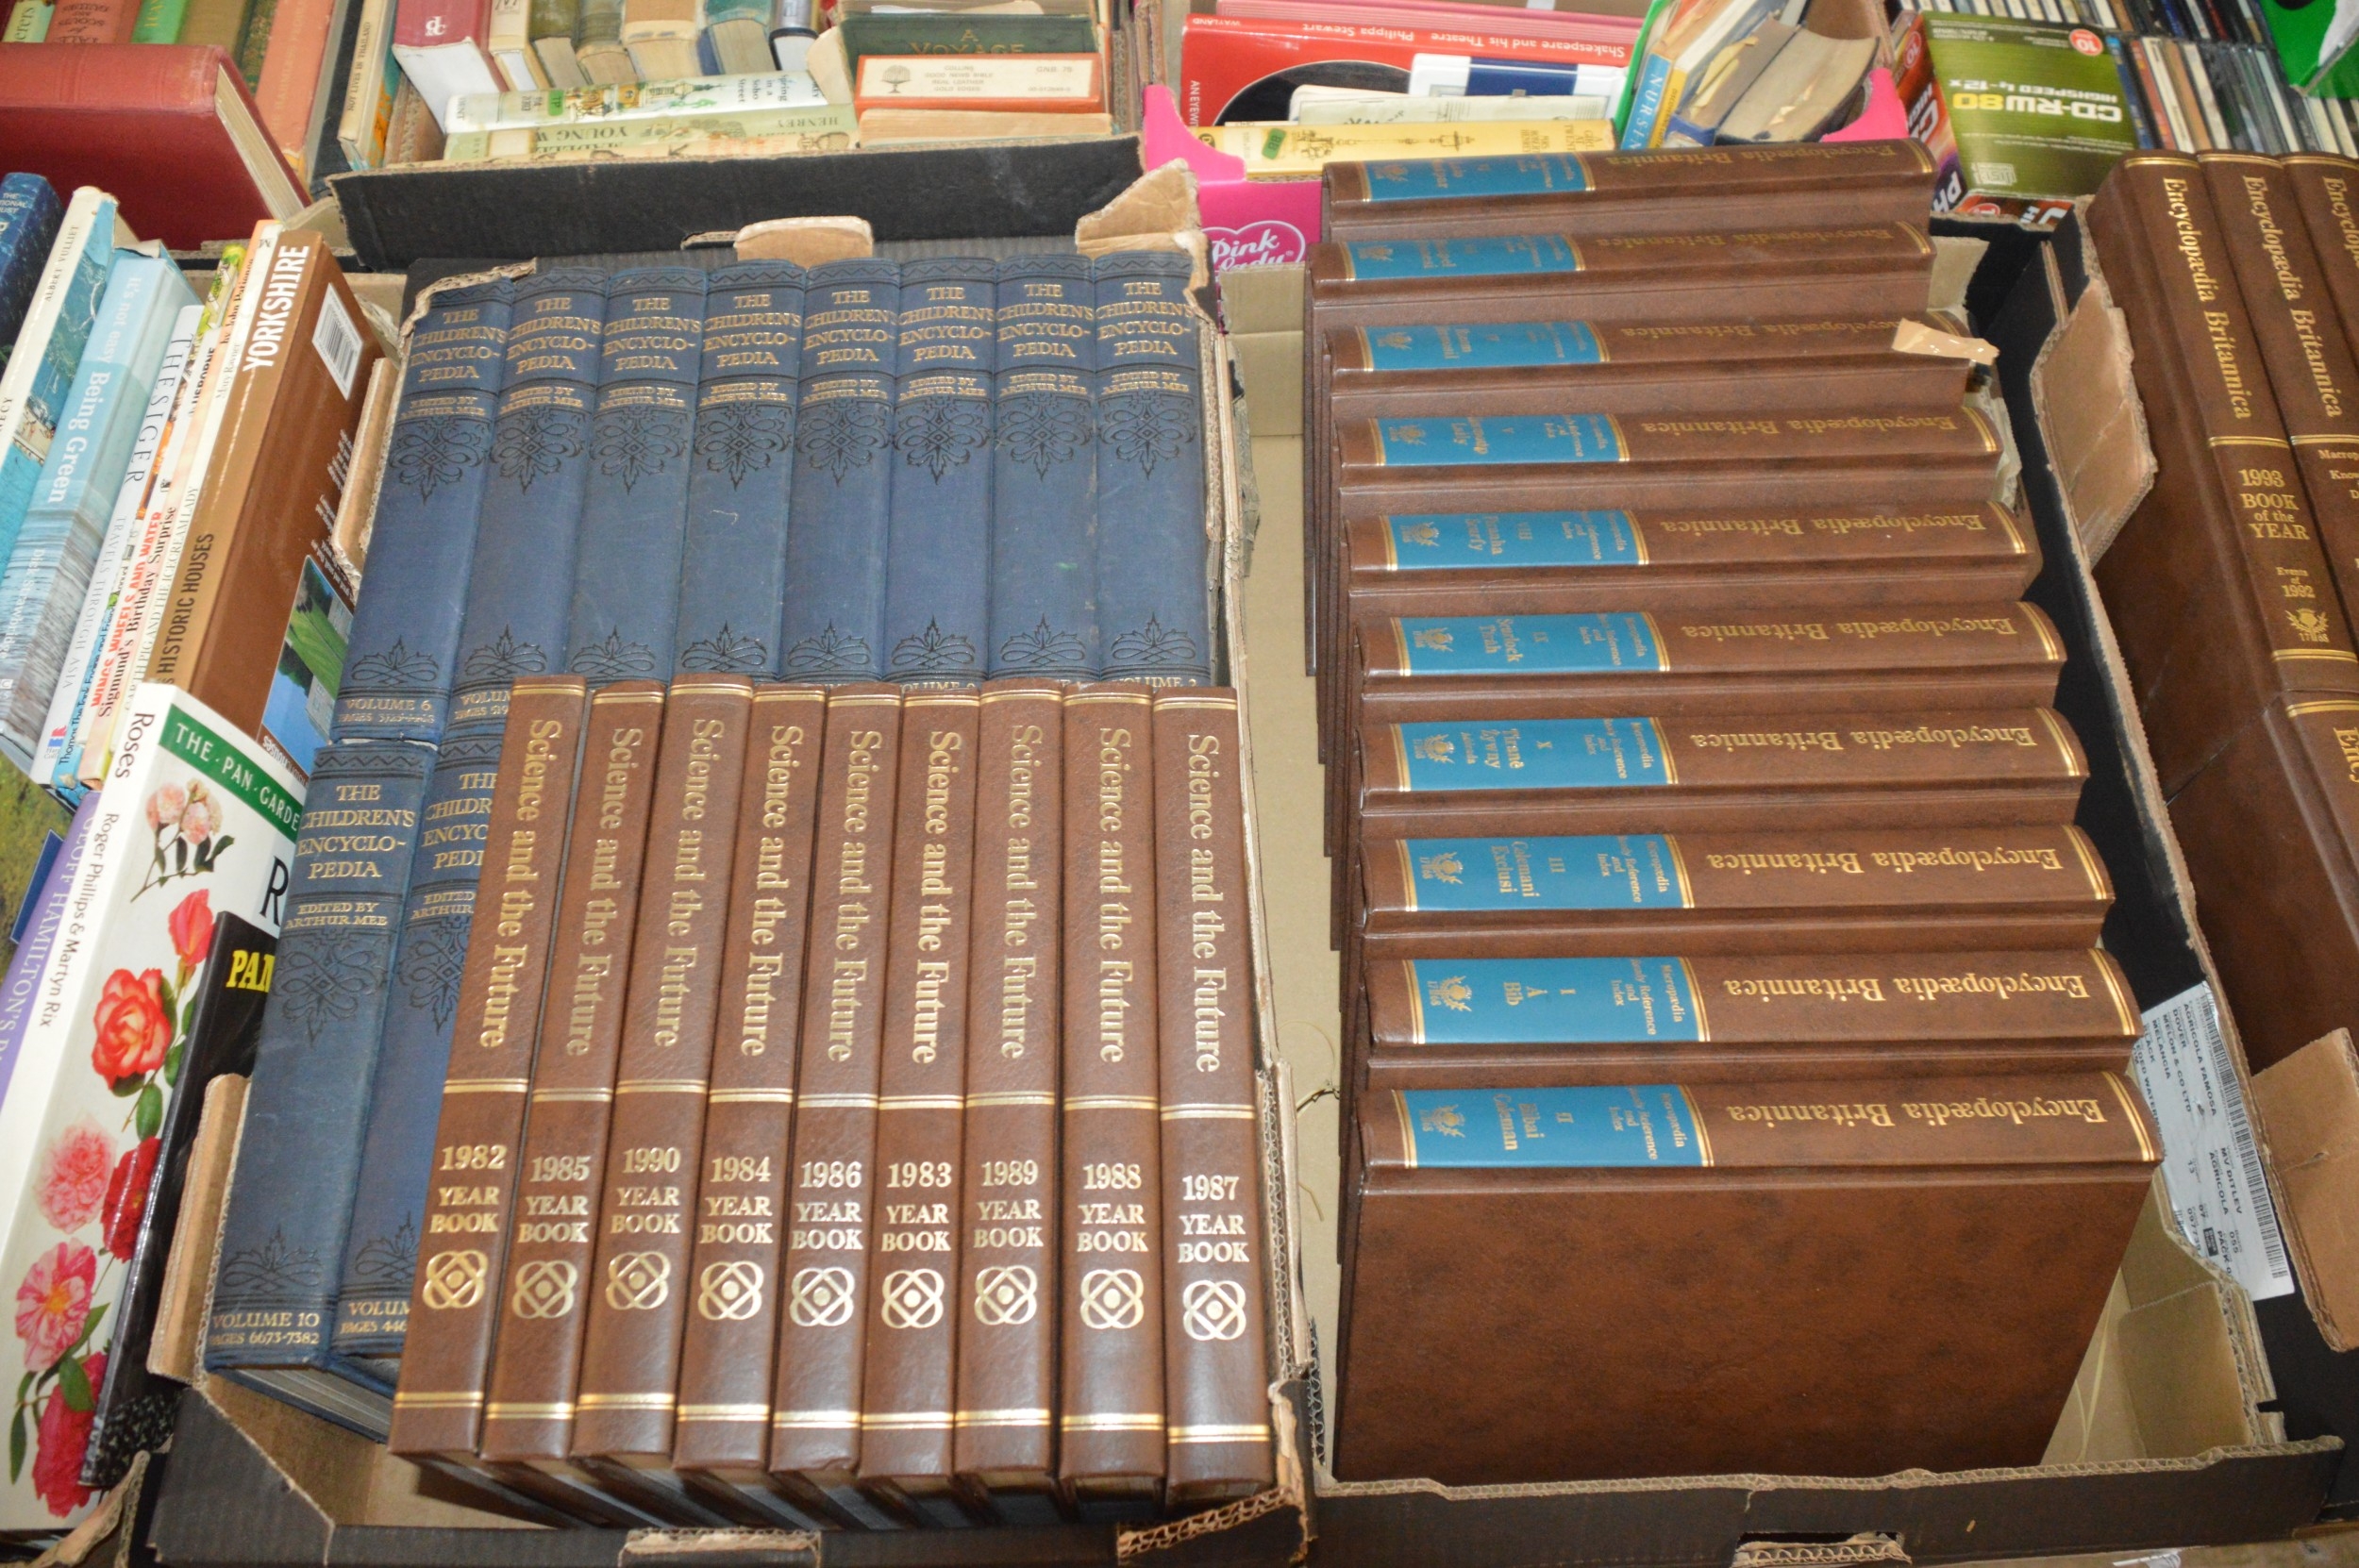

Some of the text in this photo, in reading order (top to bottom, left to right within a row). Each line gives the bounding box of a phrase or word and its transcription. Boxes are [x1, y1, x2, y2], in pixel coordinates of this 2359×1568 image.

[1193, 18, 1241, 26] WAYLAND
[961, 29, 979, 42] A
[1302, 24, 1625, 58] Shakespeare and his Theatre Philippa Stewart
[2078, 40, 2097, 54] 10
[2019, 84, 2117, 103] HIGHSPEED
[557, 126, 627, 140] YOUNG
[778, 116, 838, 128] HENREY
[1212, 228, 1280, 264] Pink
[44, 267, 63, 302] ALBERT
[926, 287, 965, 301] THE
[1024, 284, 1063, 298] THE
[243, 245, 310, 372] YORKSHIRE
[535, 298, 572, 311] THE
[899, 306, 995, 325] CHILDREN'S
[996, 303, 1094, 321] CHILDREN'S
[509, 317, 602, 341] CHILDREN'S
[899, 325, 993, 347] ENCYCLO-
[996, 325, 1092, 342] ENCYCLO-
[507, 336, 596, 360] ENCYCLO-
[913, 345, 977, 361] PEDIA
[1012, 342, 1077, 358] PEDIA
[517, 357, 576, 374] PEDIA
[2204, 310, 2252, 419] Britannica
[2289, 308, 2343, 418] Britannica
[48, 276, 142, 503] It's not easy Being Green
[1000, 383, 1054, 396] ARTHUR
[1009, 374, 1079, 385] EDITED BY
[125, 333, 193, 484] THESIGER
[2238, 469, 2285, 488] 1993
[2241, 493, 2300, 510] BOOK
[1661, 517, 1803, 536] Britannica
[2253, 510, 2295, 523] of the
[2249, 523, 2310, 540] YEAR
[2276, 567, 2309, 576] Events
[62, 515, 126, 690] TRAVELS THROUGH ASIA
[2281, 585, 2316, 599] 1992
[98, 507, 176, 718] Sigmund's Birthday Surprise
[157, 533, 214, 674] HISTORIC HOUSES
[345, 699, 432, 712] VOLUME 6
[115, 713, 155, 778] Roses
[1690, 732, 1844, 751] Britannica
[176, 723, 212, 762] THE
[222, 755, 253, 792] PAN
[336, 785, 381, 801] THE
[300, 809, 416, 830] CHILDREN'S
[295, 836, 407, 858] ENCYCLO-
[307, 861, 383, 879] PEDIA
[1491, 845, 1518, 894] Exclusi
[1511, 841, 1540, 898] Colemani
[1706, 852, 1865, 874] Britannica
[479, 719, 562, 1048] Science and the Future
[297, 902, 379, 914] EDITED BY
[912, 730, 962, 1064] Science and the Future
[1187, 734, 1227, 1073] Science and the Future
[40, 812, 120, 1028] Roger Phillips & Martyn Rix
[284, 915, 388, 929] ARTHUR MEE
[1503, 981, 1524, 1007] Bib
[1526, 985, 1548, 999] A
[1611, 978, 1624, 1007] Index
[1724, 978, 1887, 1002] Britannica
[2162, 1013, 2180, 1054] MELON
[2172, 1009, 2187, 1049] DOVER
[2151, 1019, 2171, 1080] MELANCIA
[2183, 1003, 2217, 1117] AGRICOLA FAMOSA
[2176, 1070, 2187, 1088] CO
[2180, 1090, 2192, 1113] LTD
[1492, 1093, 1519, 1150] Coleman
[1518, 1102, 1546, 1140] Bibai
[1727, 1105, 1896, 1127] Britannica
[440, 1144, 508, 1171] 1982
[623, 1147, 681, 1173] 1990
[2219, 1146, 2231, 1167] MV
[529, 1156, 591, 1182] 1985
[710, 1156, 772, 1182] 1984
[800, 1161, 862, 1189] 1986
[886, 1161, 953, 1188] 1983
[980, 1159, 1039, 1187] 1989
[1082, 1162, 1143, 1191] 1988
[1181, 1175, 1240, 1201] 1987
[2208, 1151, 2229, 1216] AGRICOLA
[438, 1186, 500, 1206] YEAR
[616, 1187, 680, 1207] YEAR
[705, 1195, 773, 1217] YEAR
[428, 1212, 499, 1233] BOOK
[610, 1213, 681, 1234] BOOK
[885, 1203, 950, 1225] YEAR
[1179, 1213, 1246, 1236] YEAR
[698, 1223, 774, 1244] BOOK
[880, 1230, 952, 1252] BOOK
[1177, 1242, 1250, 1263] BOOK
[212, 1312, 321, 1328] VOLUME 10
[249, 1331, 320, 1344] 6673-7382
